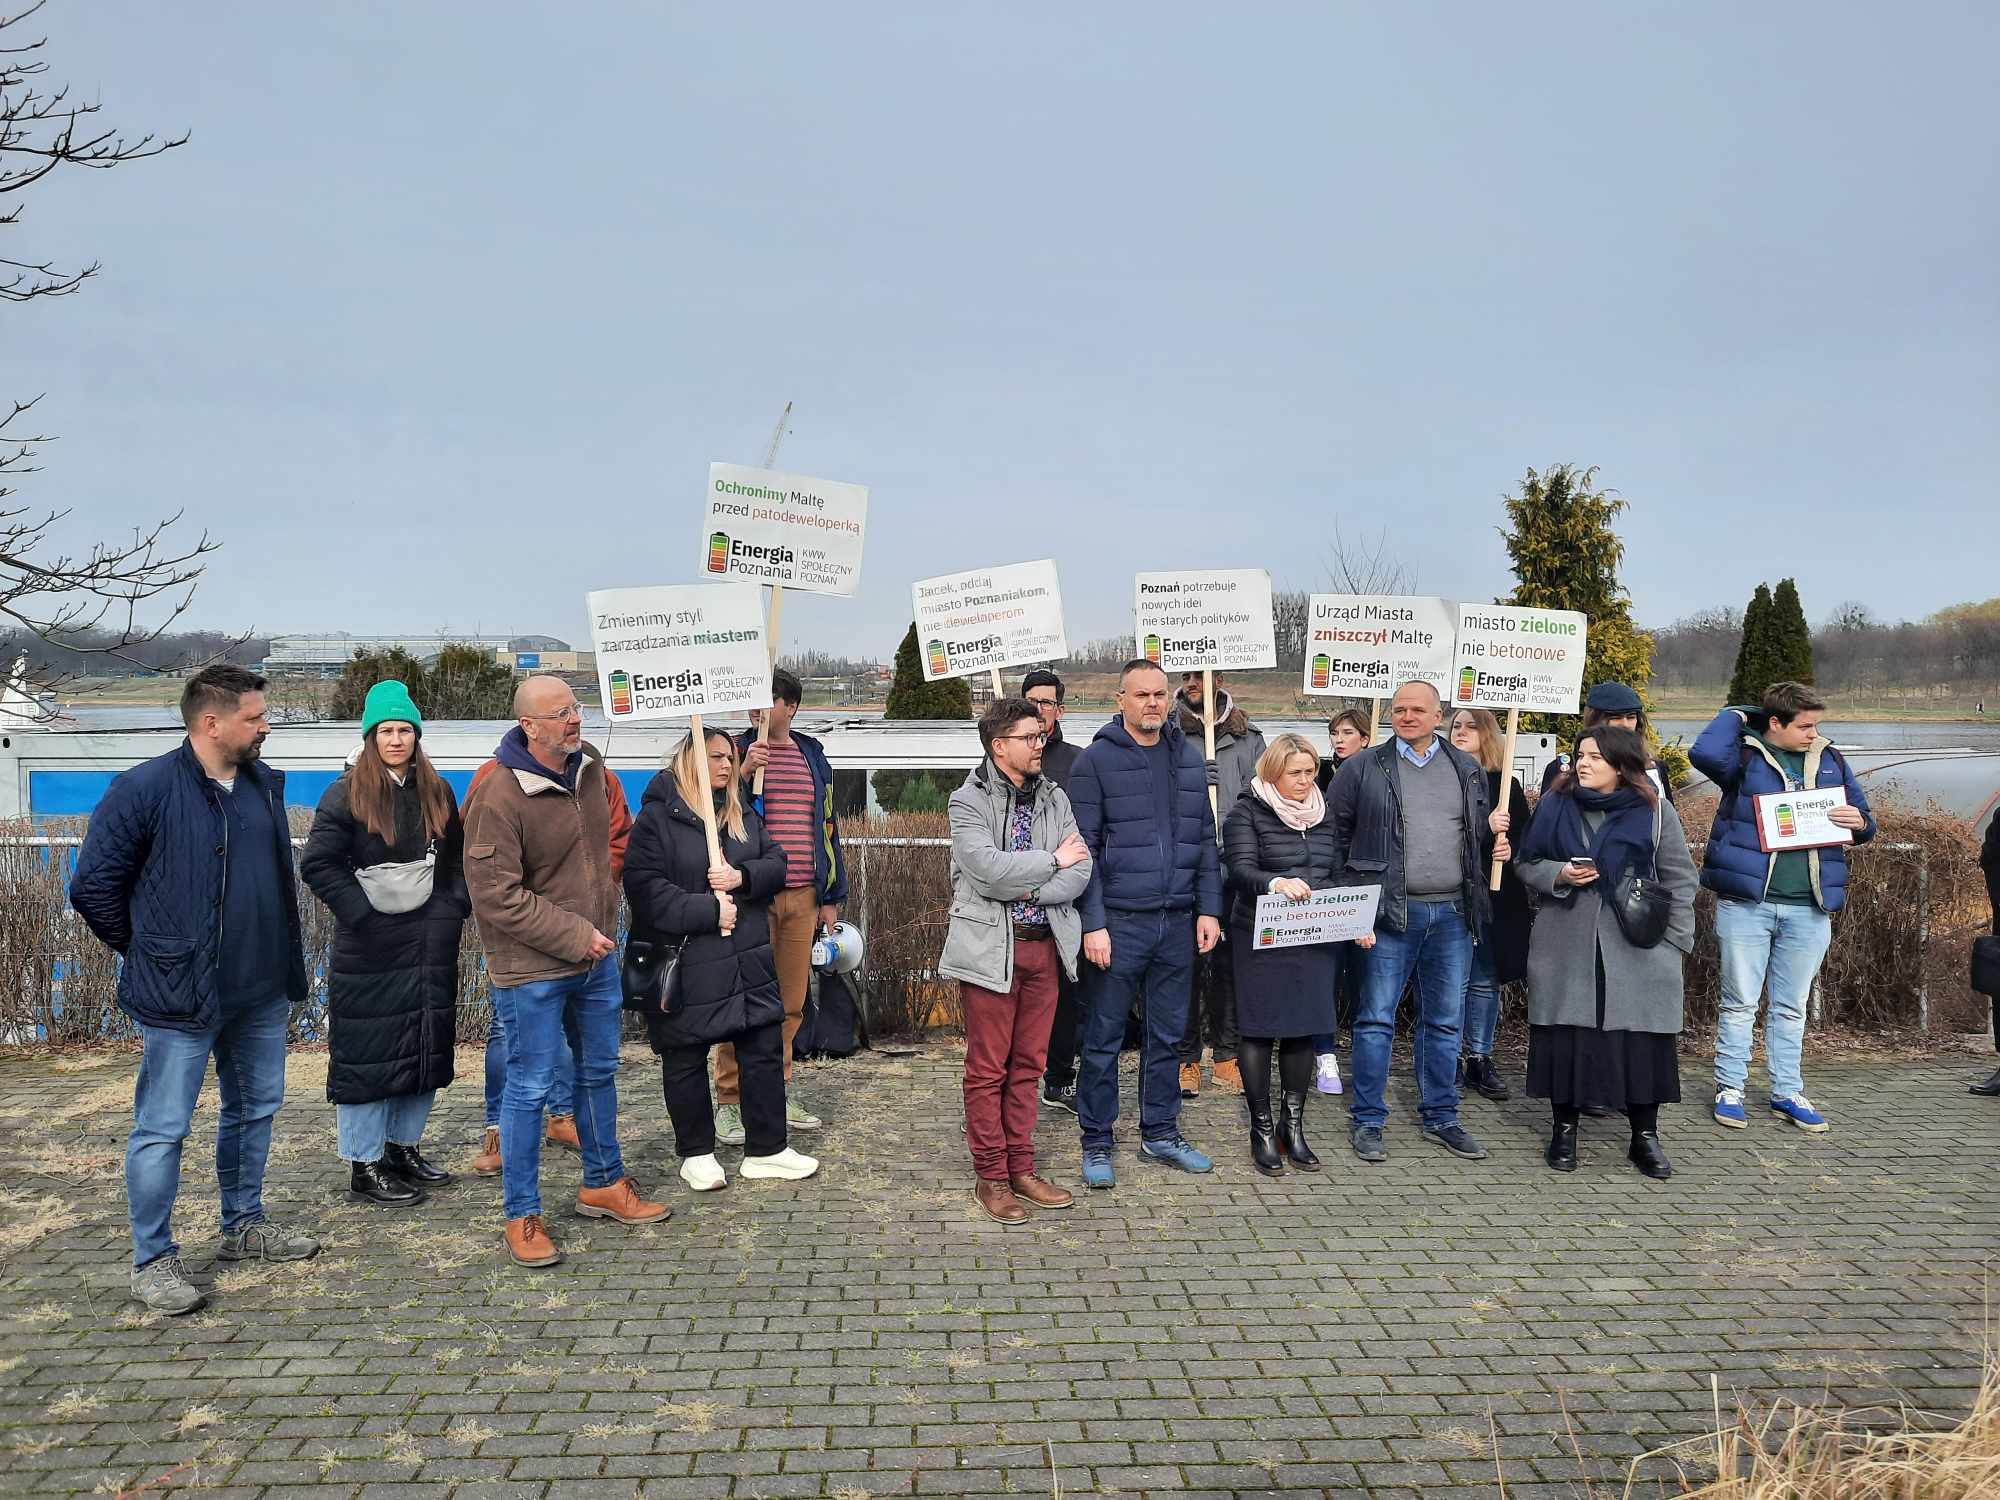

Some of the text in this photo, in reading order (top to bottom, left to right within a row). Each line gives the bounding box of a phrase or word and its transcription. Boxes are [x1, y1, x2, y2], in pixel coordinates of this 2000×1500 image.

[716, 480, 824, 510] Ochronimy Maltę
[713, 502, 860, 536] przed patodeweloperką
[732, 540, 793, 564] Energia
[803, 549, 825, 559] KWW
[731, 559, 792, 579] Poznania
[801, 561, 852, 575] SPOŁECZNY
[800, 572, 837, 585] POZNAŃ
[919, 576, 992, 598] Jacek, oddaj
[1141, 580, 1236, 593] Poznań potrzebuje
[921, 586, 1049, 615] miasto Poznaniakom,
[1142, 598, 1202, 611] nowych idei
[598, 608, 703, 629] Zmienimy styl
[1142, 611, 1250, 627] nie starych polityków
[1317, 604, 1413, 622] Urząd Miasta
[924, 621, 942, 632] nie
[1464, 613, 1576, 635] miasto zielone
[602, 630, 758, 653] zarządzania miastem
[947, 634, 1003, 655] Energia
[1163, 636, 1216, 654] Energia
[1314, 627, 1432, 648] zniszczył Maltę
[1462, 639, 1566, 661] nie betonowe
[950, 650, 1005, 670] Poznania
[1164, 652, 1217, 666] Poznania
[1398, 661, 1420, 669] KWW
[710, 666, 735, 676] KWW
[1332, 659, 1389, 677] Energia
[633, 669, 703, 691] Energia
[712, 676, 764, 689] SPOŁECZNY
[1332, 675, 1388, 689] Poznania
[1478, 672, 1527, 691] Energia
[636, 690, 704, 710] Poznania
[714, 688, 750, 702] POZNAŃ
[1476, 688, 1526, 702] Poznania
[1796, 798, 1835, 810] Energia
[1263, 893, 1368, 909] miasto zielone
[1261, 908, 1357, 923] nie betonowe
[1276, 926, 1321, 936] Energia
[1276, 935, 1320, 944] Poznania
